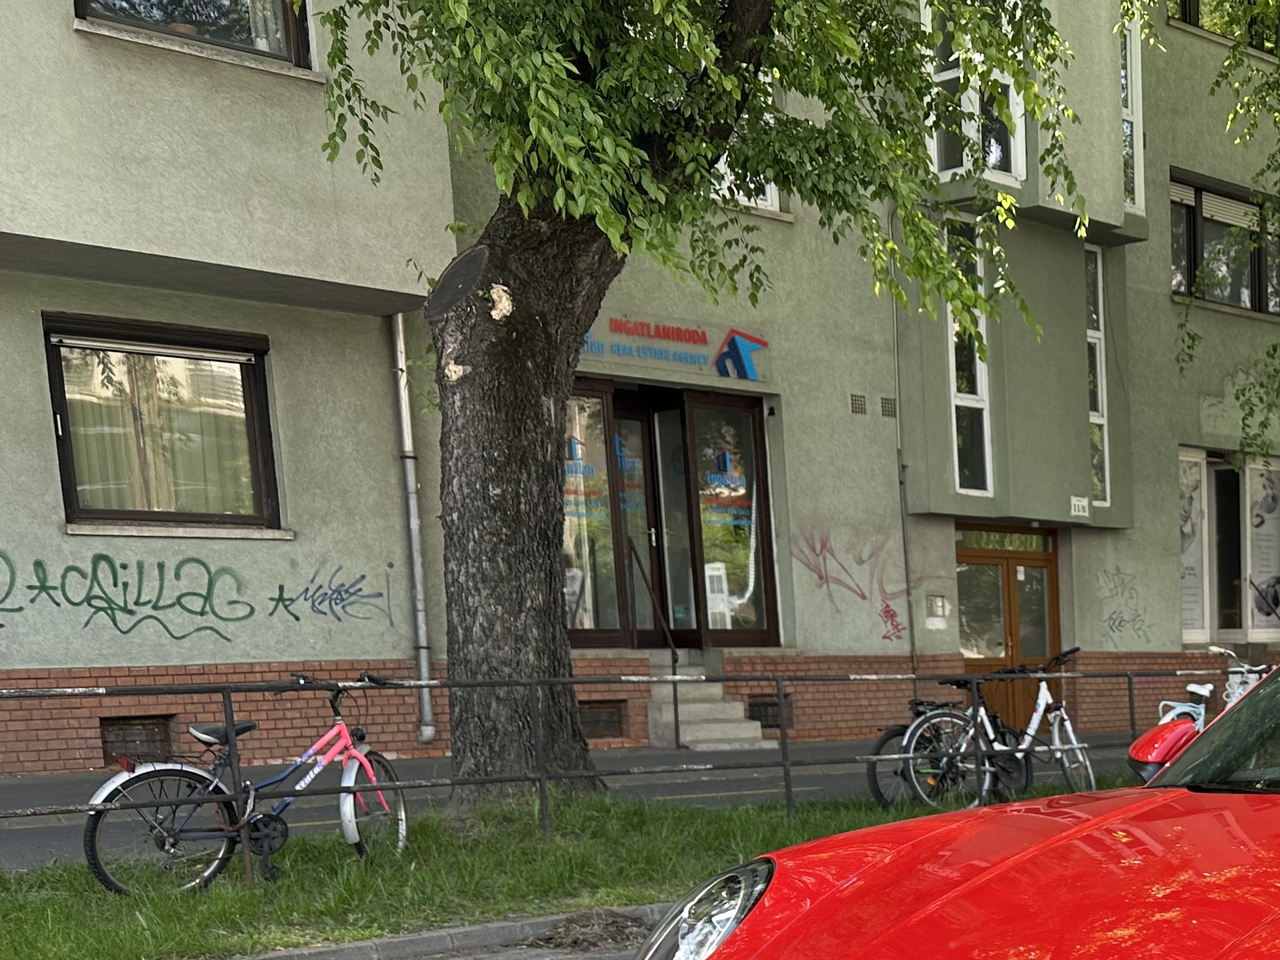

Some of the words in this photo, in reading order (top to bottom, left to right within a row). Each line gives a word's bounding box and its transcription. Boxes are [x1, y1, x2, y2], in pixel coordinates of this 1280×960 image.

[609, 317, 708, 346] INGATLANIRODA
[611, 343, 635, 357] REAL
[637, 345, 671, 360] ESTATE
[673, 351, 709, 365] AGENCY
